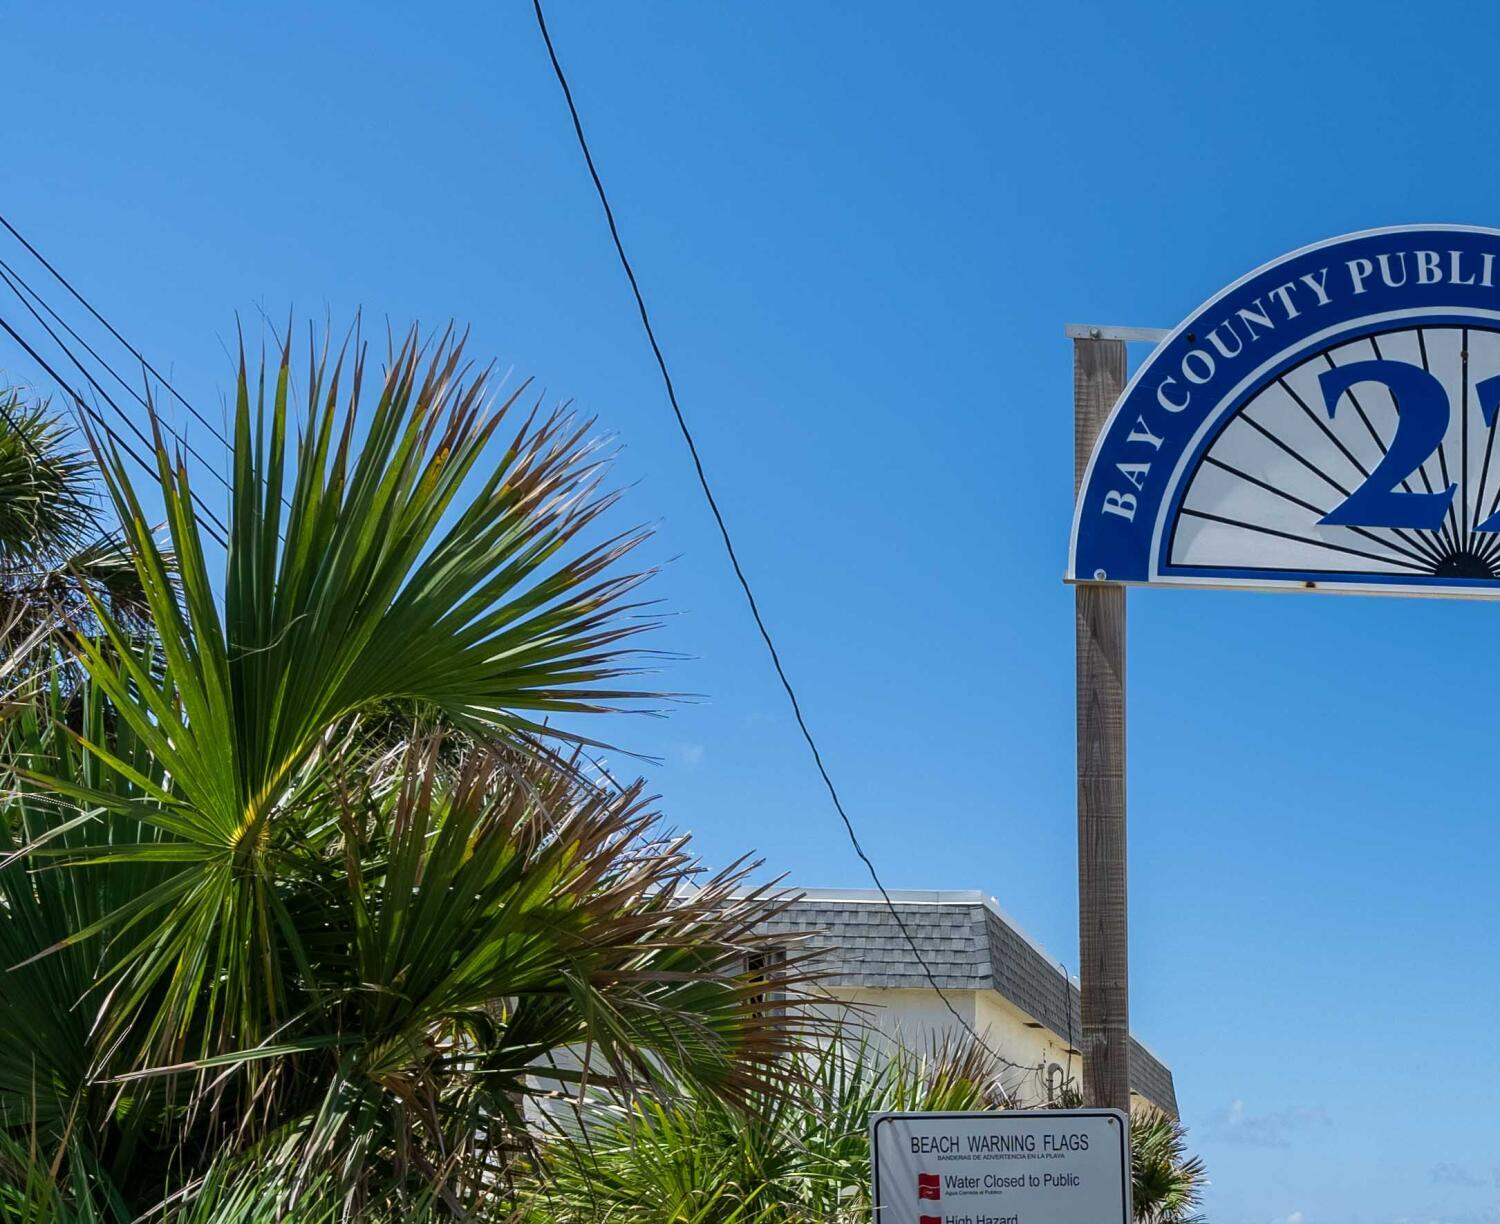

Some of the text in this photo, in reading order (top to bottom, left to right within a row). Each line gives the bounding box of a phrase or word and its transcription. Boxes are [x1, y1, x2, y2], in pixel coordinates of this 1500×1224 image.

[1101, 414, 1164, 523] BAY
[1157, 268, 1332, 413] COUNTY
[910, 1133, 1089, 1154] BEACH WARNING FLAGS
[944, 1173, 1080, 1189] Water Closed to Public
